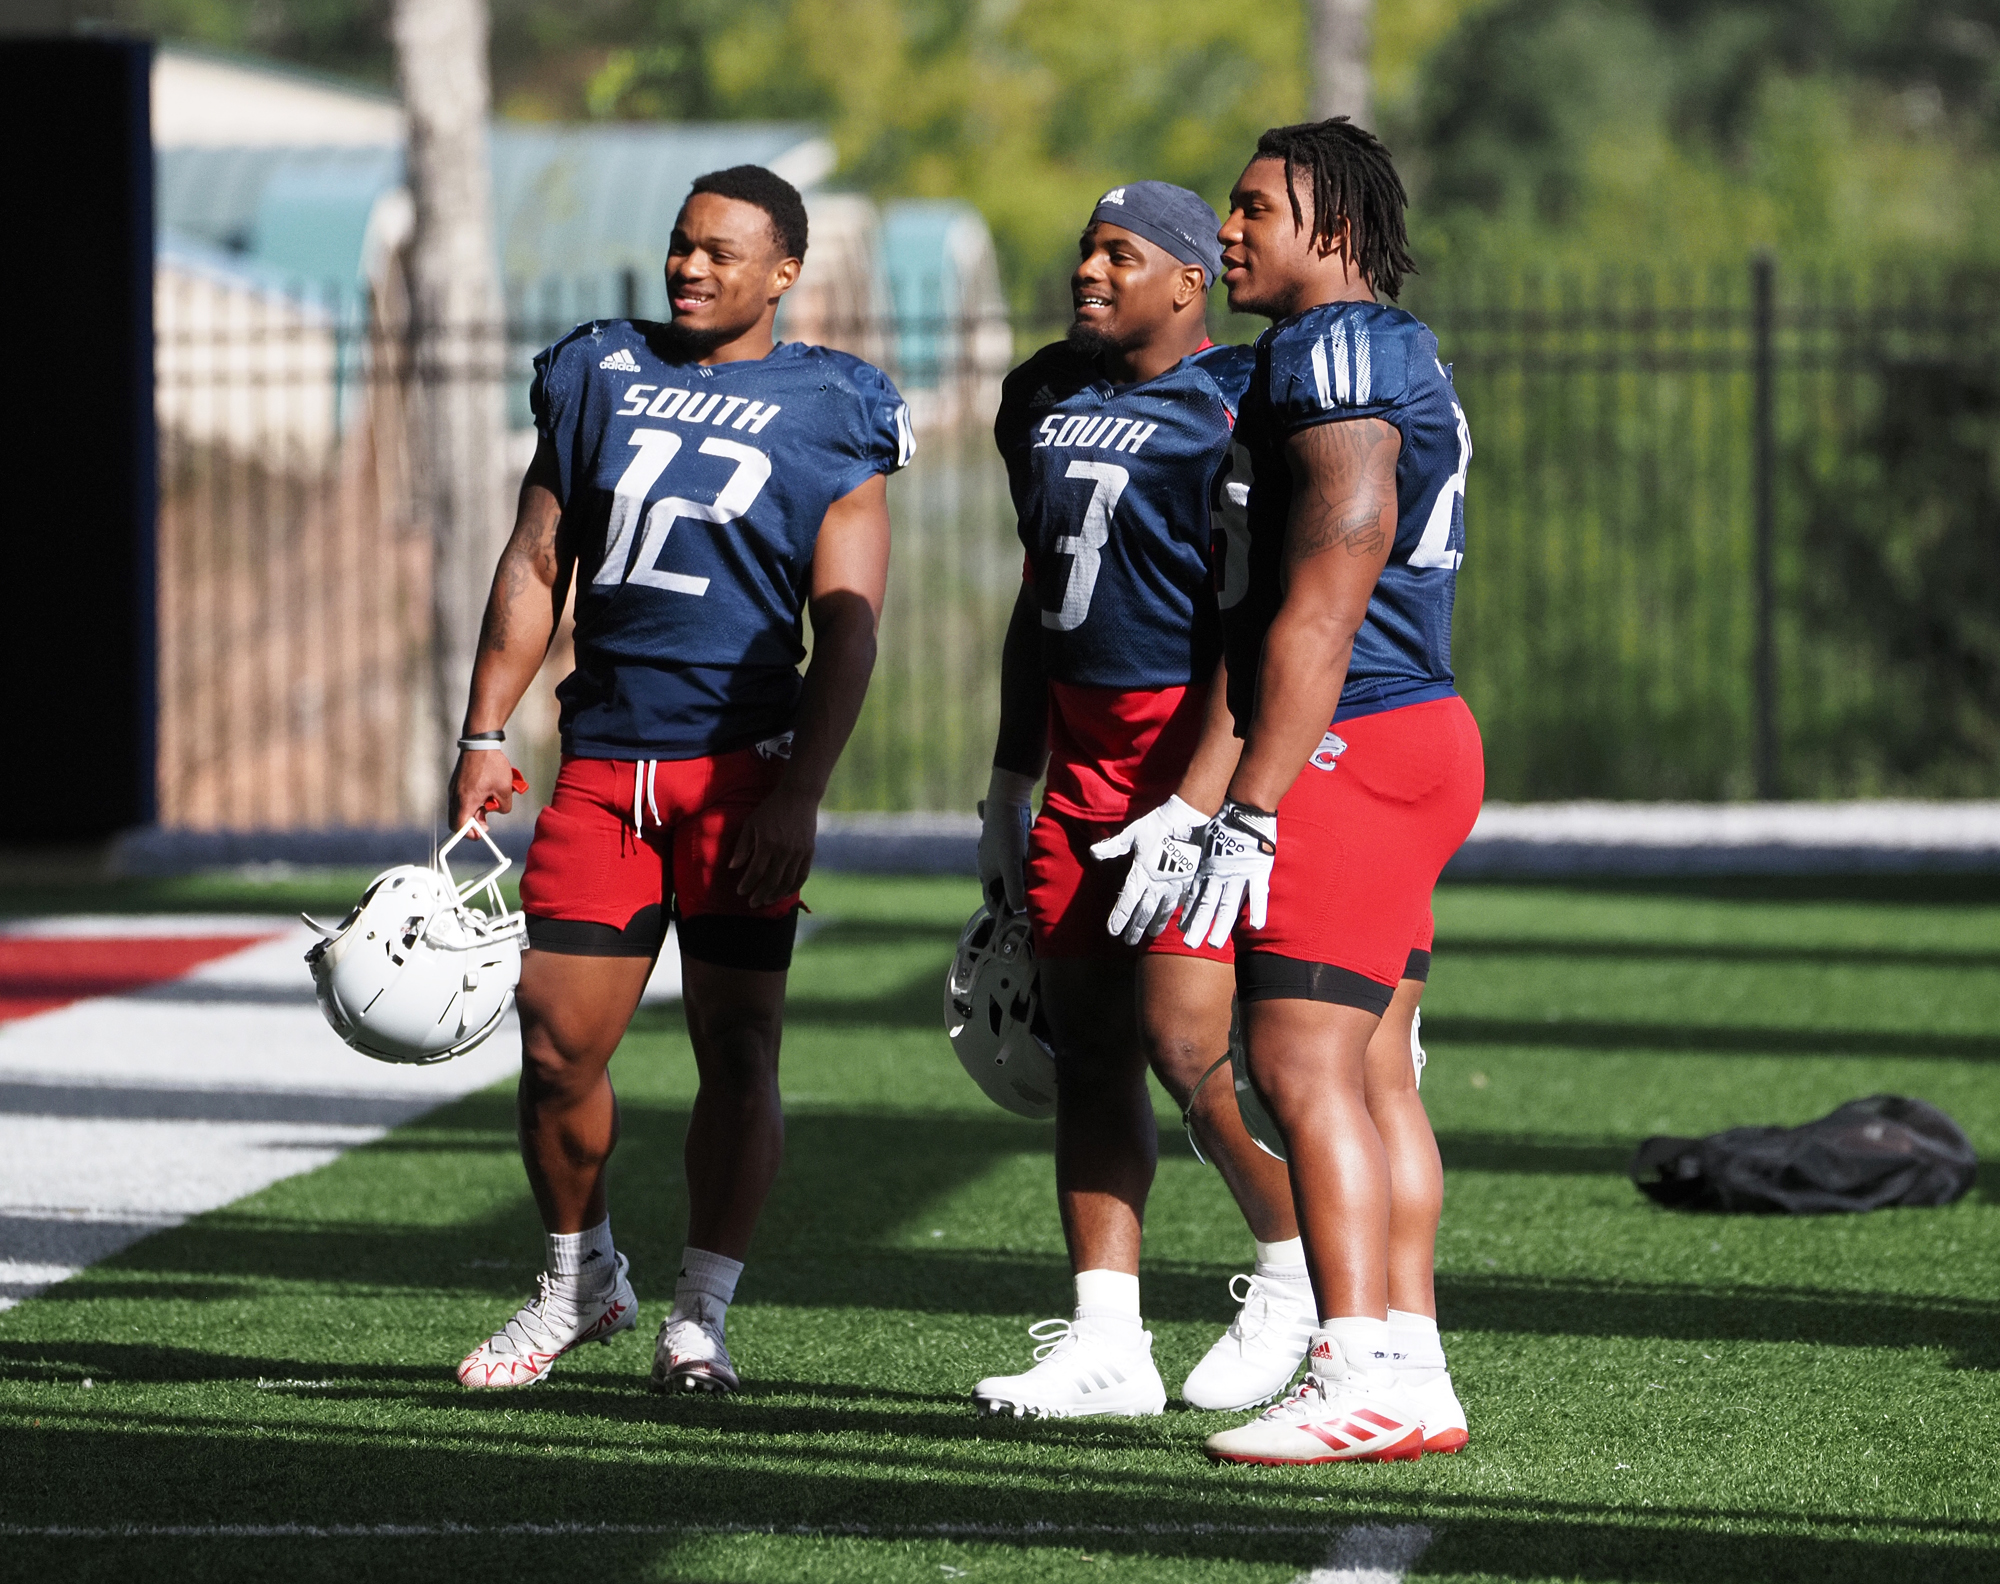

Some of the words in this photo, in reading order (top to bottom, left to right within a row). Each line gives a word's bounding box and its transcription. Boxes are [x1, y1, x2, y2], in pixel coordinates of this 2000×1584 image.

[599, 360, 641, 373] adidas
[616, 384, 781, 434] SOUTH
[1033, 414, 1158, 454] SOUTH
[592, 428, 772, 597] 12
[1041, 460, 1130, 632] 3
[1161, 836, 1194, 871] adidas
